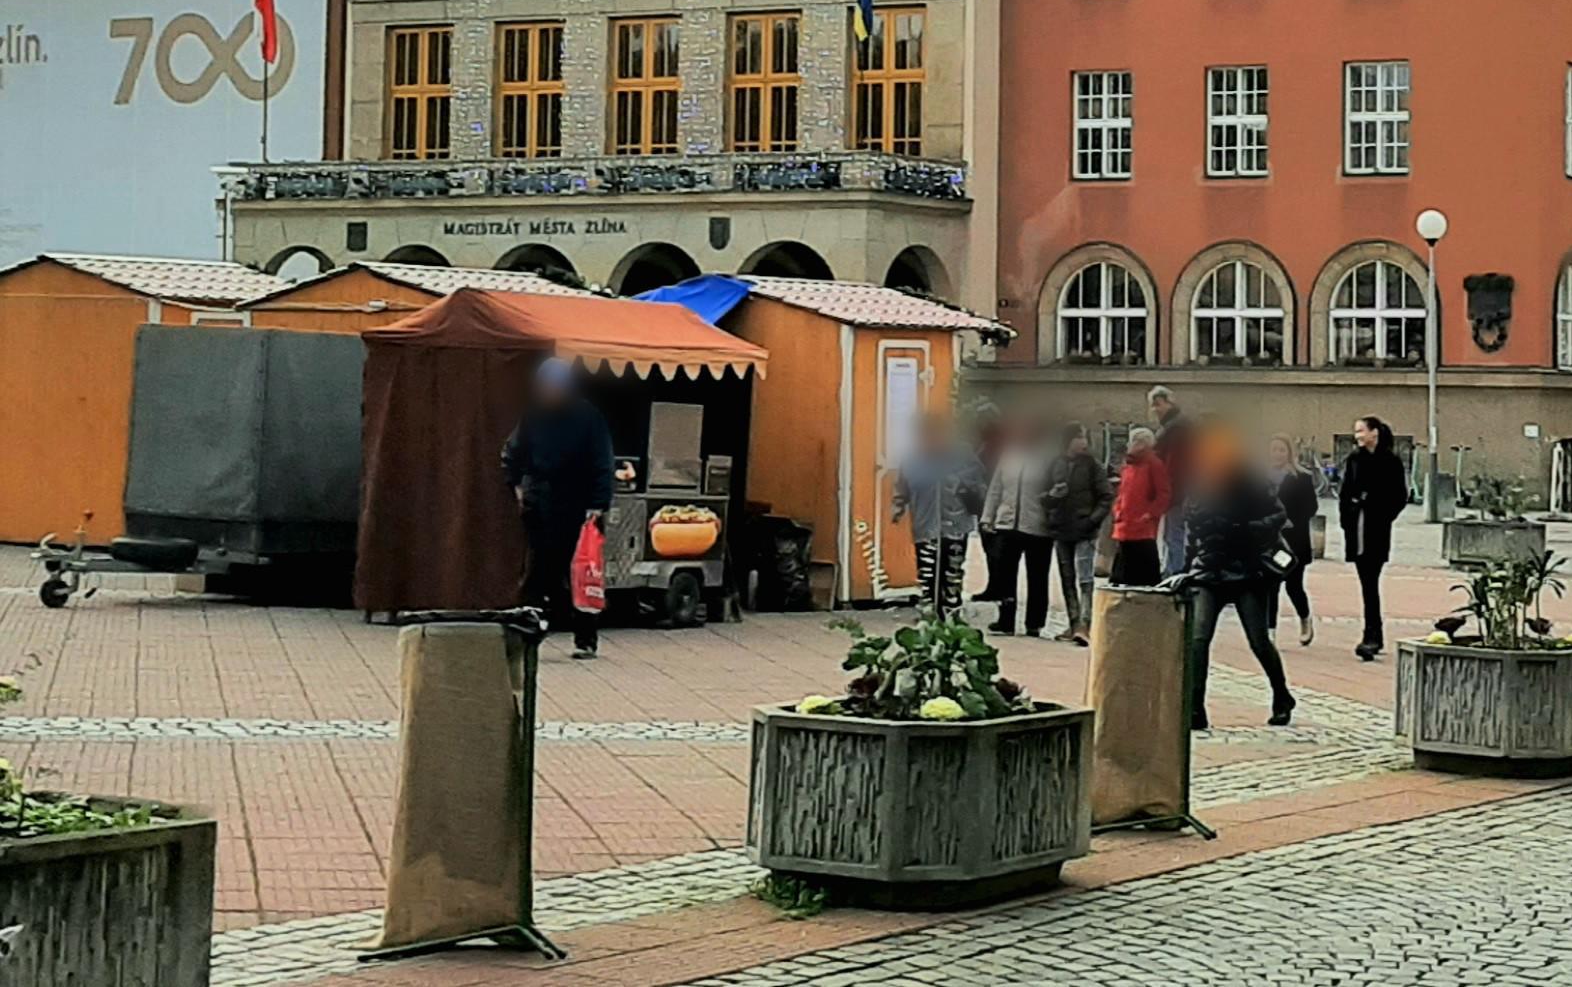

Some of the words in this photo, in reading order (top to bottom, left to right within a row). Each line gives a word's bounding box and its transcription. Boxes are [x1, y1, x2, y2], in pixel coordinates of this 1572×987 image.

[443, 218, 520, 235] MAGISTRÁT
[529, 216, 576, 234] MĚSTA
[584, 217, 627, 234] ZLÍNA
